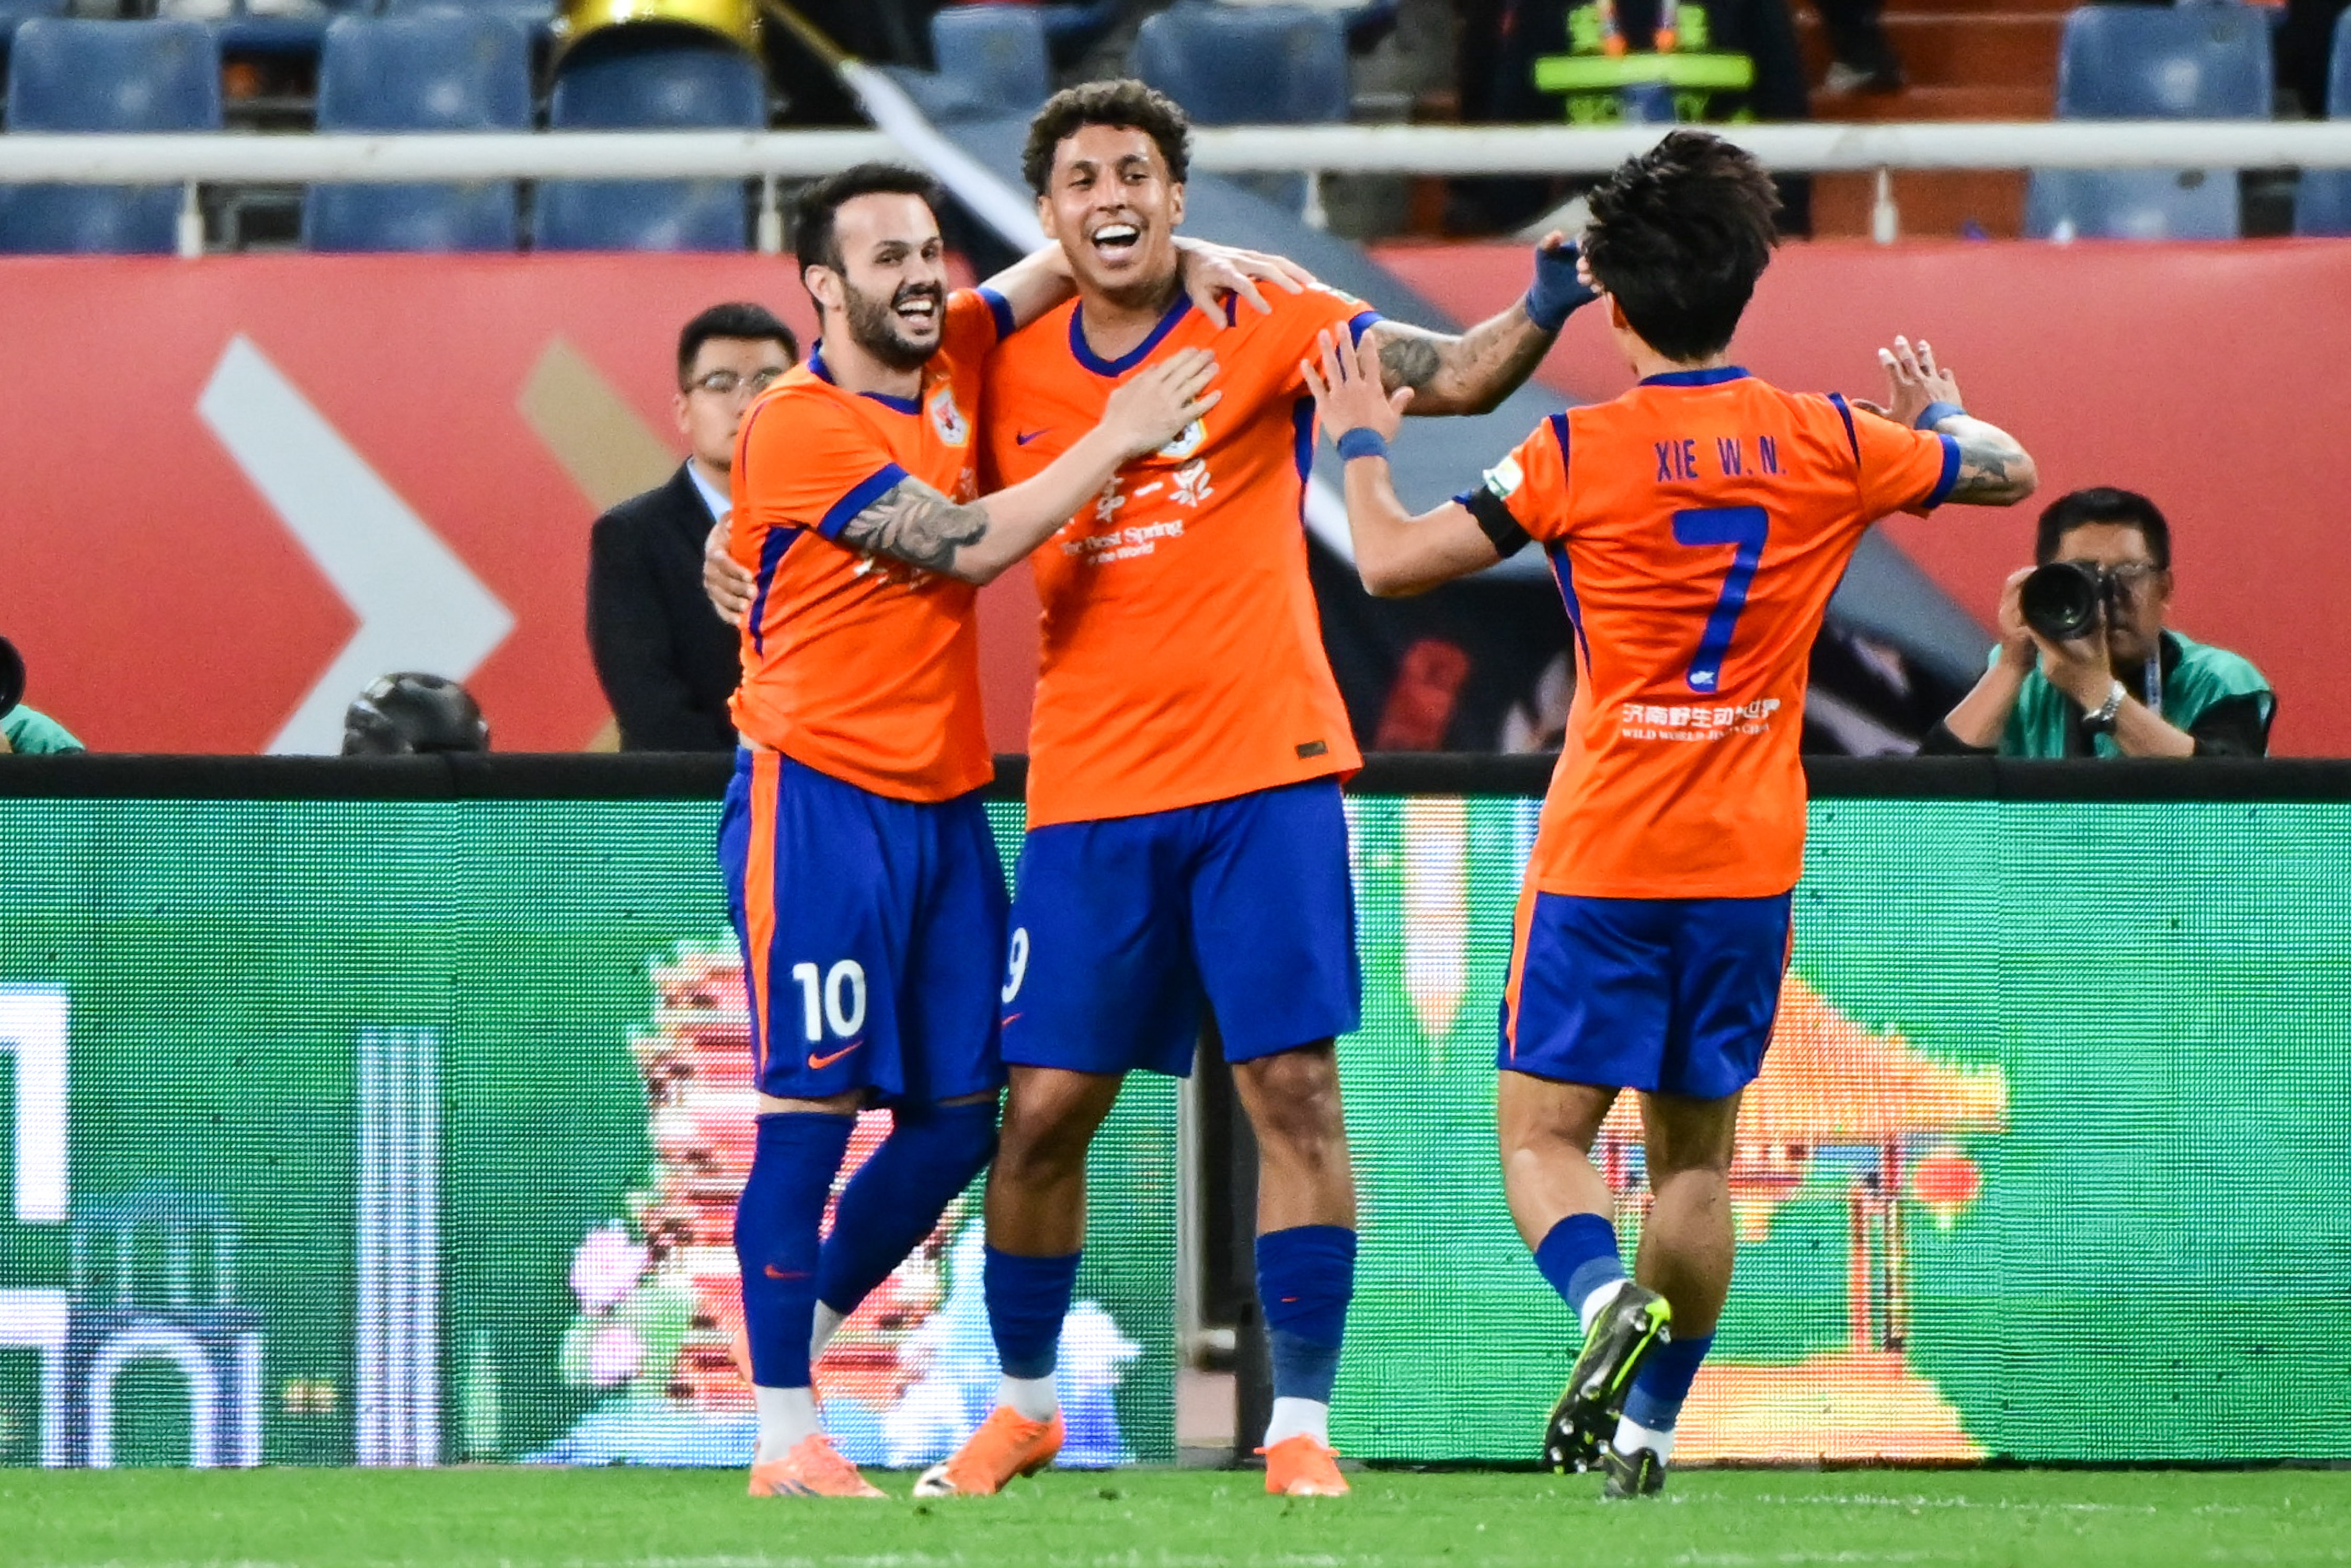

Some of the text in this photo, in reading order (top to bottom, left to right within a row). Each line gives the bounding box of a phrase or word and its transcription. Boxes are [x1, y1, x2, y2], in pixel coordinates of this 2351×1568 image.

[1655, 439, 1699, 482] XIE
[1123, 519, 1184, 545] Spring
[1672, 505, 1769, 694] 7
[1622, 728, 1657, 740] WILD
[1001, 927, 1029, 1004] 9
[792, 959, 866, 1042] 10
